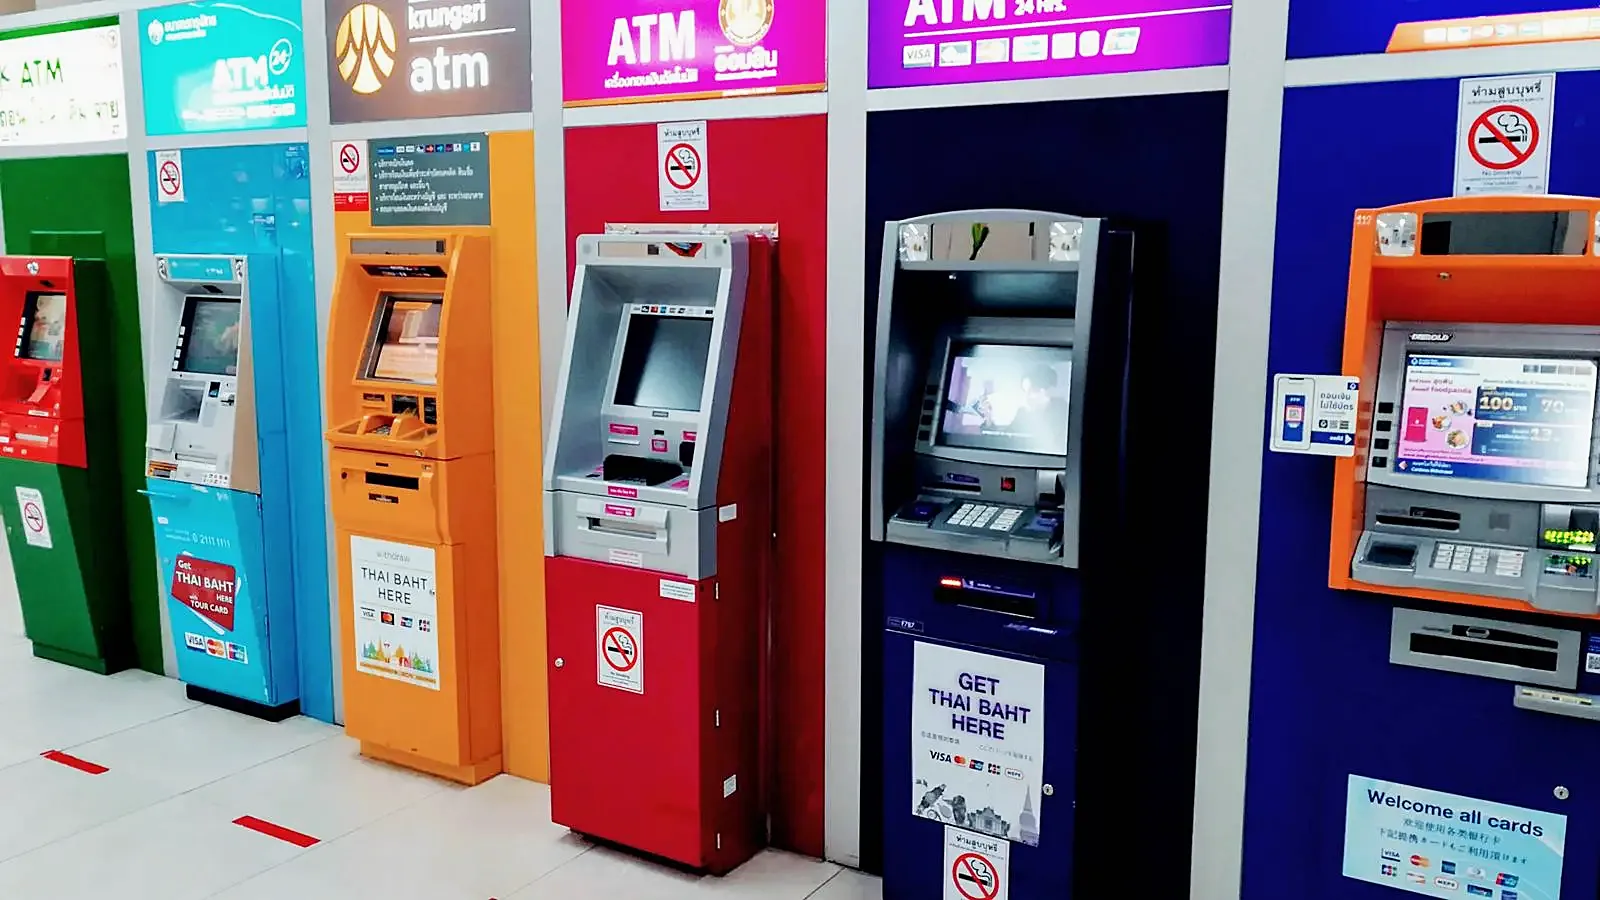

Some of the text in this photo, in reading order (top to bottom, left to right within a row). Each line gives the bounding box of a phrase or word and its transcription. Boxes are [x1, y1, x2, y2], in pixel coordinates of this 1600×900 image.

[408, 2, 486, 31] krungsri
[607, 10, 696, 66] ATM
[907, 49, 931, 60] VISA
[20, 56, 64, 89] ATM
[211, 54, 269, 92] ATM
[410, 47, 489, 92] atm
[1480, 396, 1514, 411] 100
[177, 559, 192, 570] Get
[175, 570, 234, 593] THAI BAHT
[361, 566, 428, 591] THAI BAHT
[216, 593, 233, 604] HERE
[378, 587, 412, 605] HERE
[210, 603, 229, 615] CARD
[187, 634, 204, 646] VISA
[958, 672, 1000, 696] GET
[928, 688, 1031, 724] THAI BAHT
[952, 713, 1005, 740] HERE
[929, 750, 952, 763] VISA
[1367, 788, 1544, 837] Welcome all cards
[1384, 849, 1401, 858] VISA
